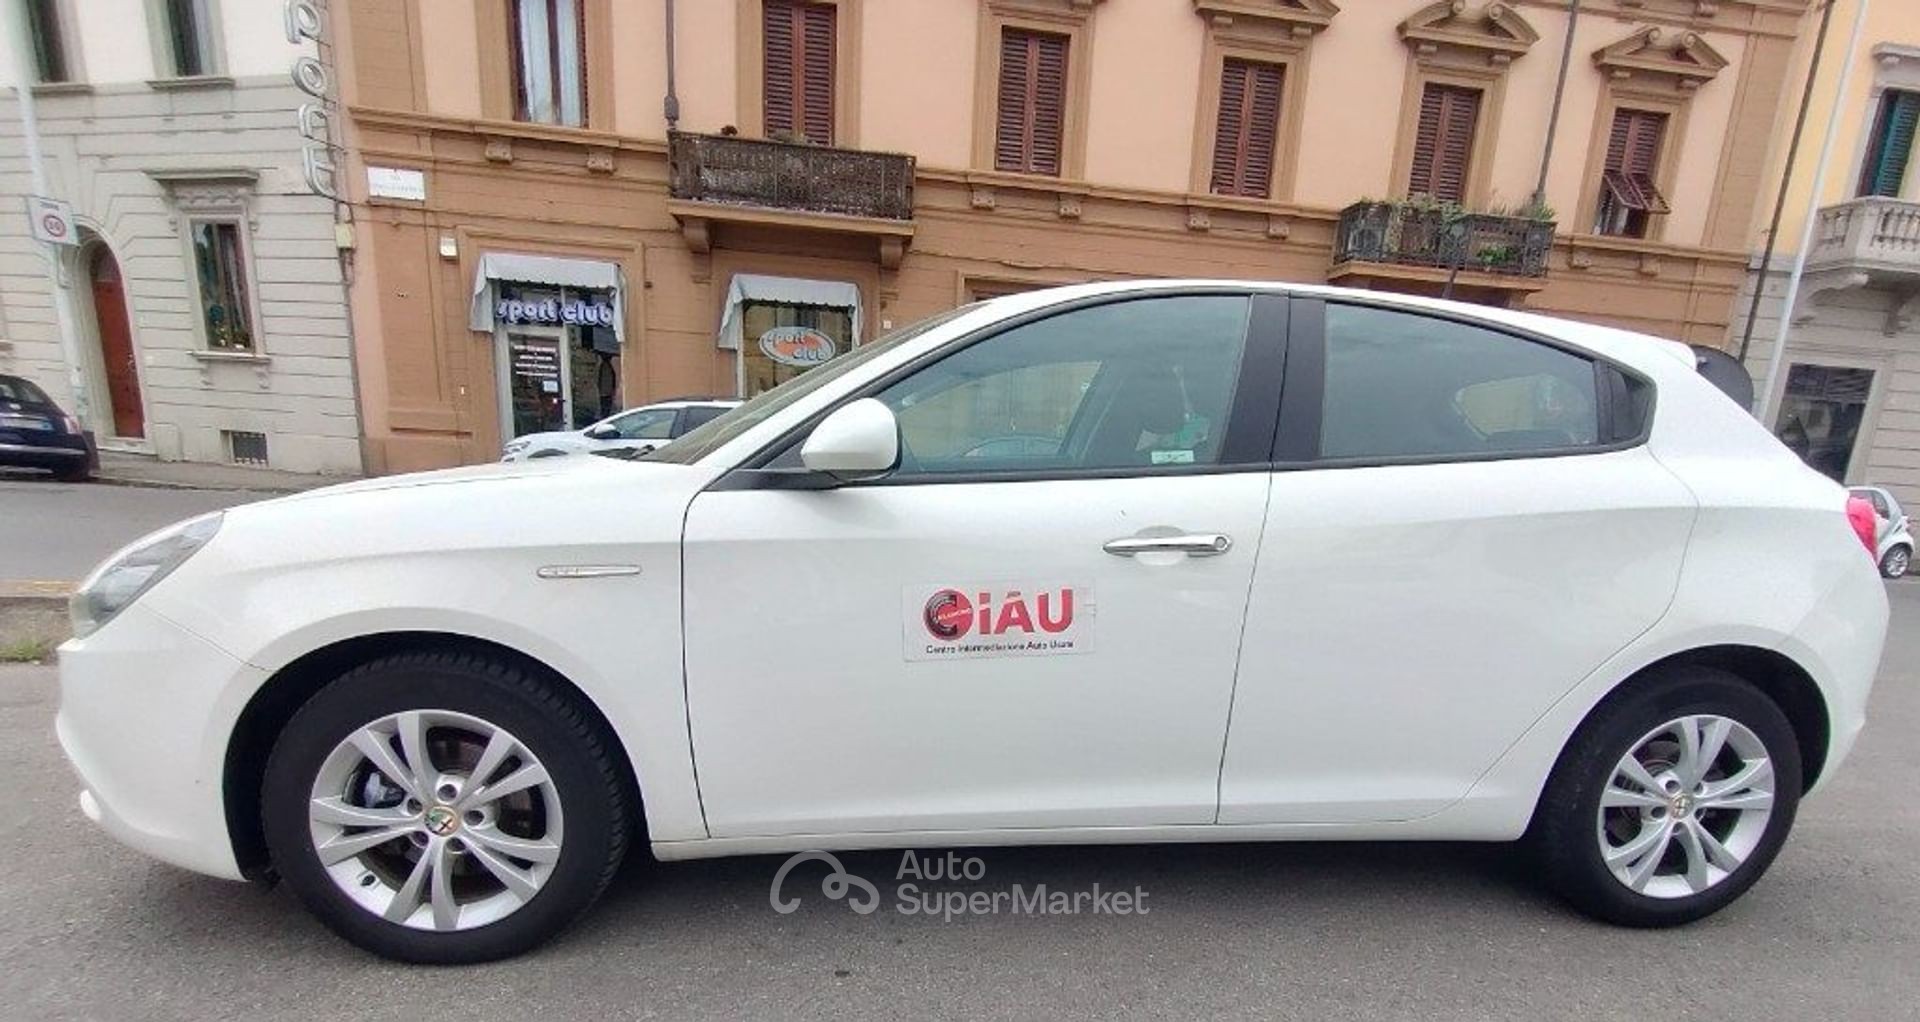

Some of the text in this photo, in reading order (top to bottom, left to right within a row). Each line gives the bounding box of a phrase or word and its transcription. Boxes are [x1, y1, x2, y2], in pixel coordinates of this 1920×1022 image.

[562, 299, 614, 327] club
[926, 644, 956, 654] Centro
[1026, 640, 1048, 650] Auto
